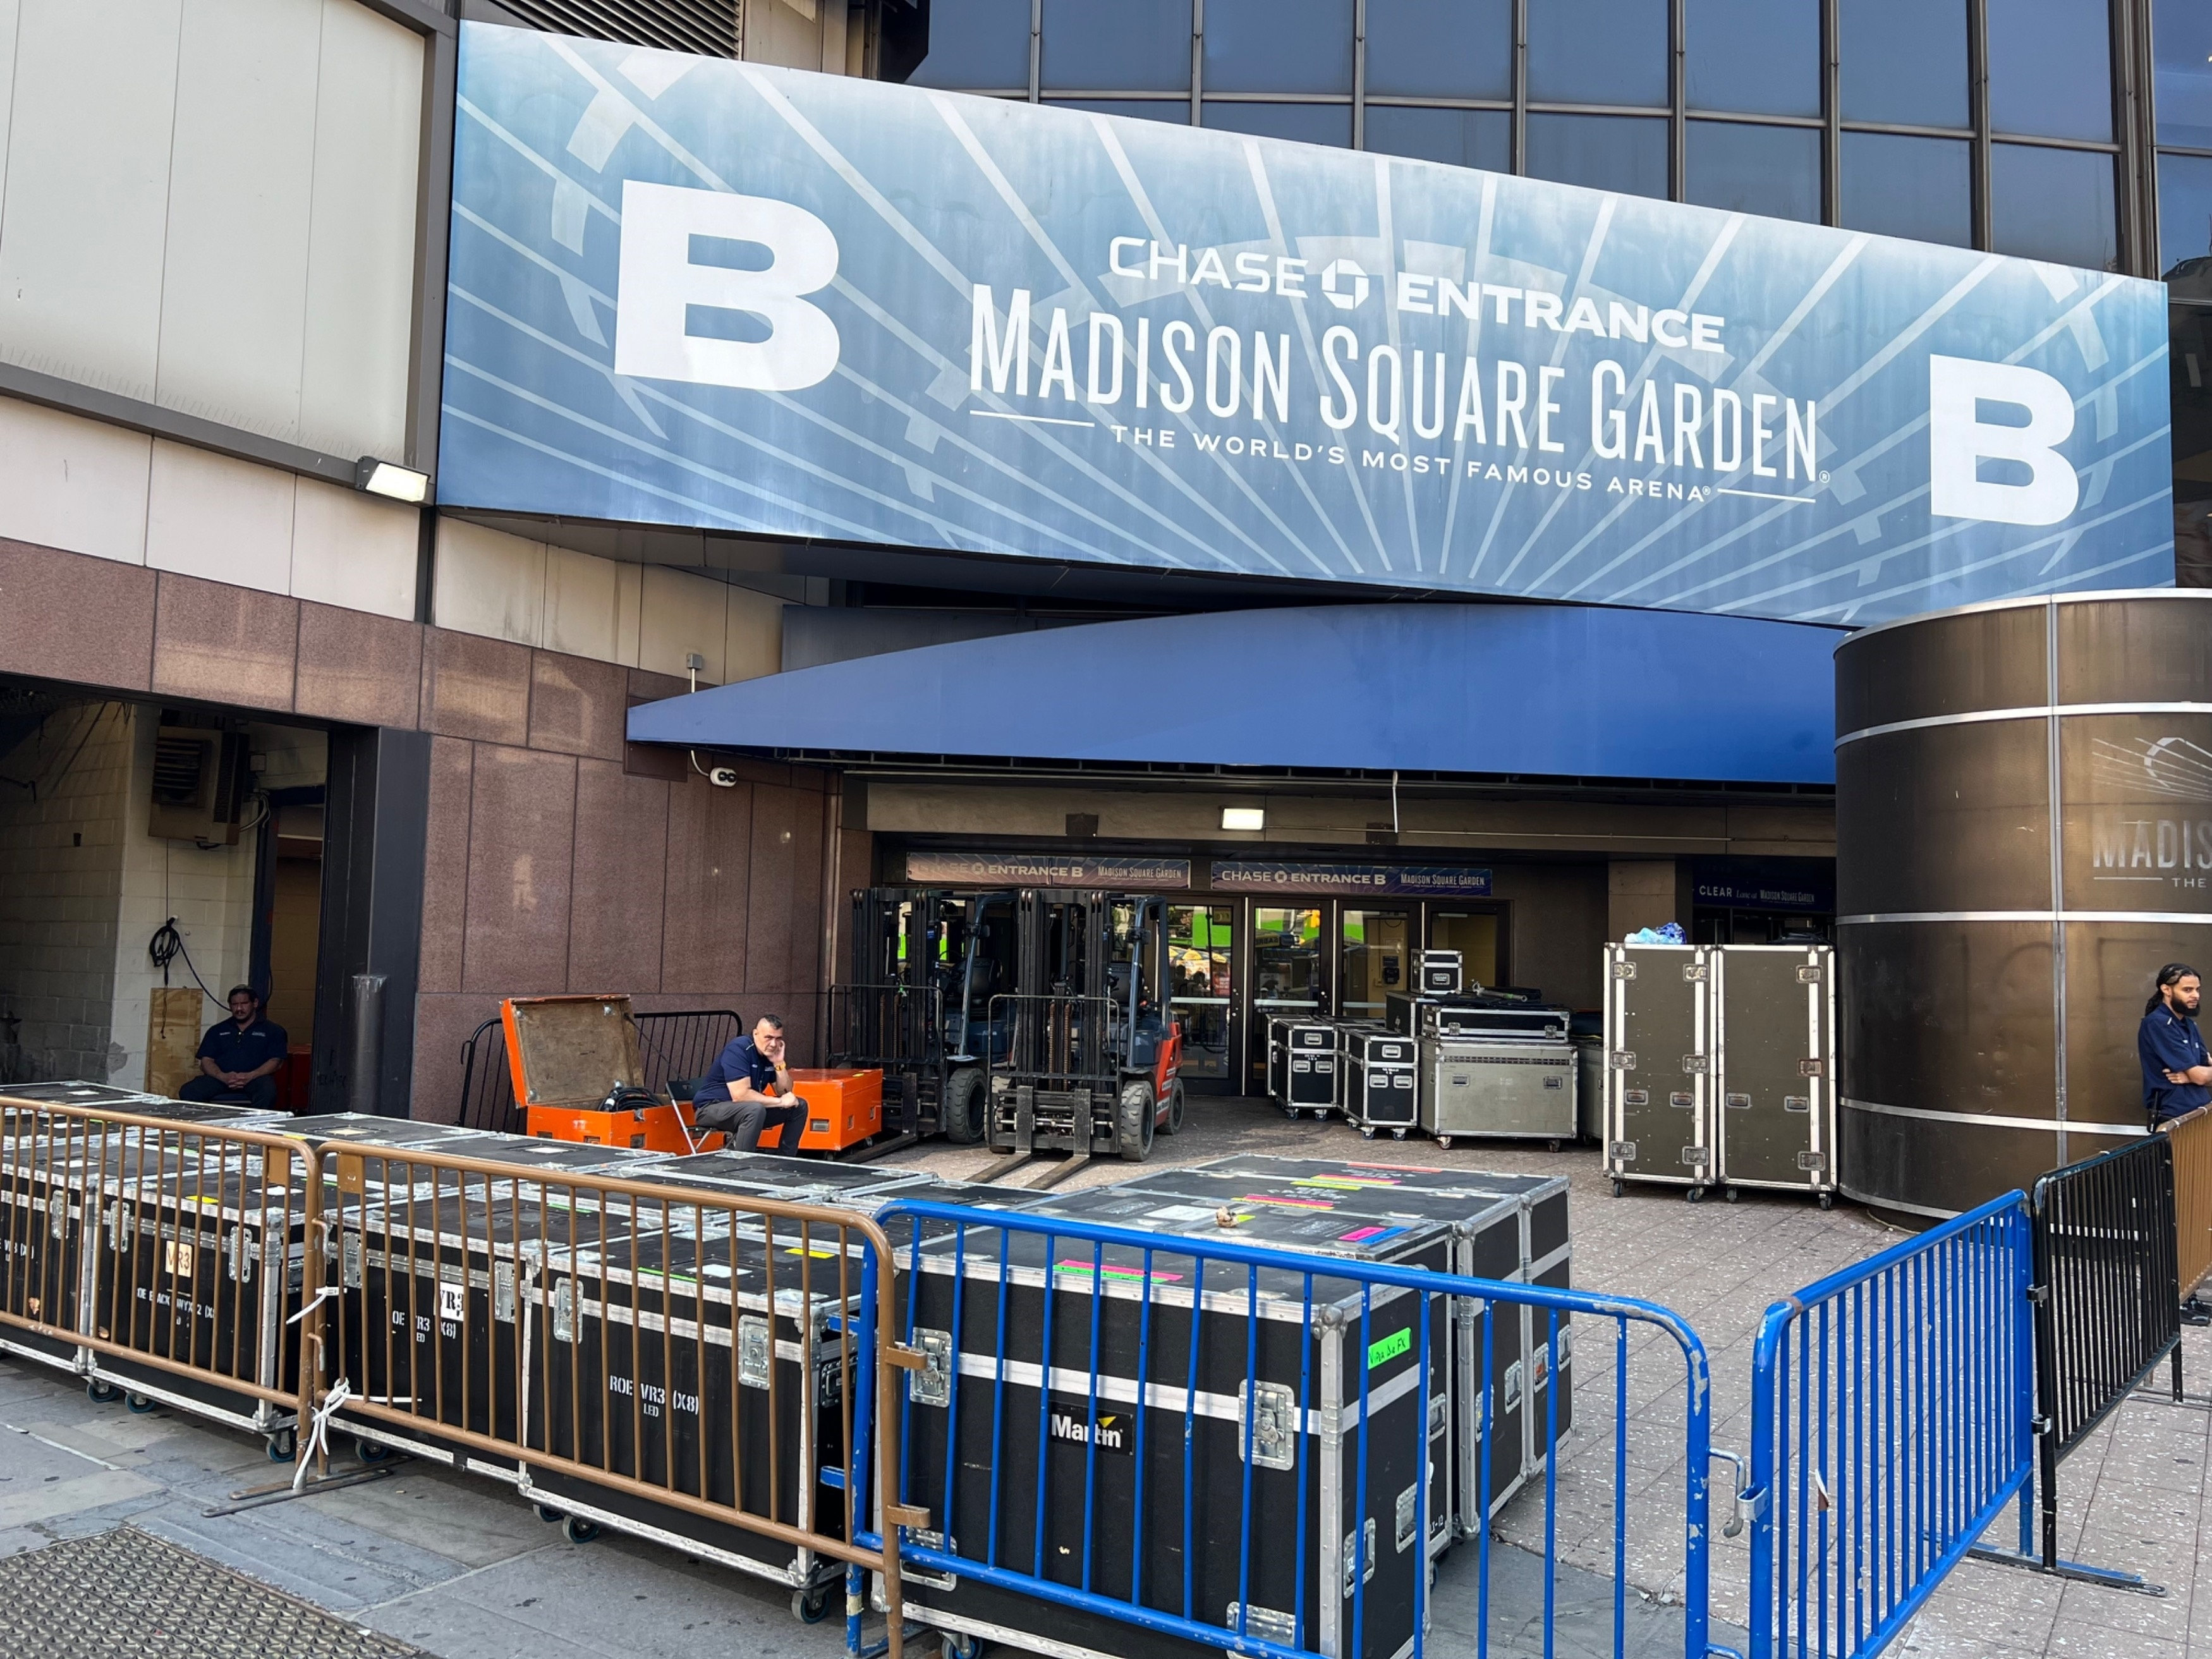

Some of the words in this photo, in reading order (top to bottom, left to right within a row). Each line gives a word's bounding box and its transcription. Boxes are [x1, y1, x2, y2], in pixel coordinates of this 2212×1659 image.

[614, 179, 840, 391] B
[1109, 236, 1308, 298] CHASE
[1397, 272, 1724, 353] ENTRANCE
[971, 283, 1290, 423] MADISON
[1320, 325, 1565, 453] SQUARE
[1929, 353, 2081, 526] B
[1110, 425, 1176, 449] THE
[1193, 432, 1345, 465] WORLD'S
[1363, 449, 1450, 475] MOST
[1468, 461, 1592, 490] FAMOUS
[988, 865, 1068, 877] ENTRANCE
[1071, 866, 1083, 877] B
[1098, 866, 1127, 877] MADISON
[1129, 866, 1154, 878] SQUARE
[1155, 868, 1182, 878] GARDEN
[1222, 870, 1272, 882] CHASE
[1291, 873, 1371, 884] ENTRANCE
[1373, 873, 1387, 885] B
[1401, 873, 1430, 884] MADISON
[1431, 874, 1457, 885] SQUARE
[1459, 875, 1485, 885] GARDEN
[2172, 877, 2207, 888] THE
[1699, 885, 1732, 897] CLEAR
[609, 1375, 633, 1396] ROE
[640, 1383, 665, 1404] VR3
[672, 1390, 700, 1416] (X8)
[643, 1402, 659, 1417] LED
[1052, 1413, 1122, 1449] Martin
